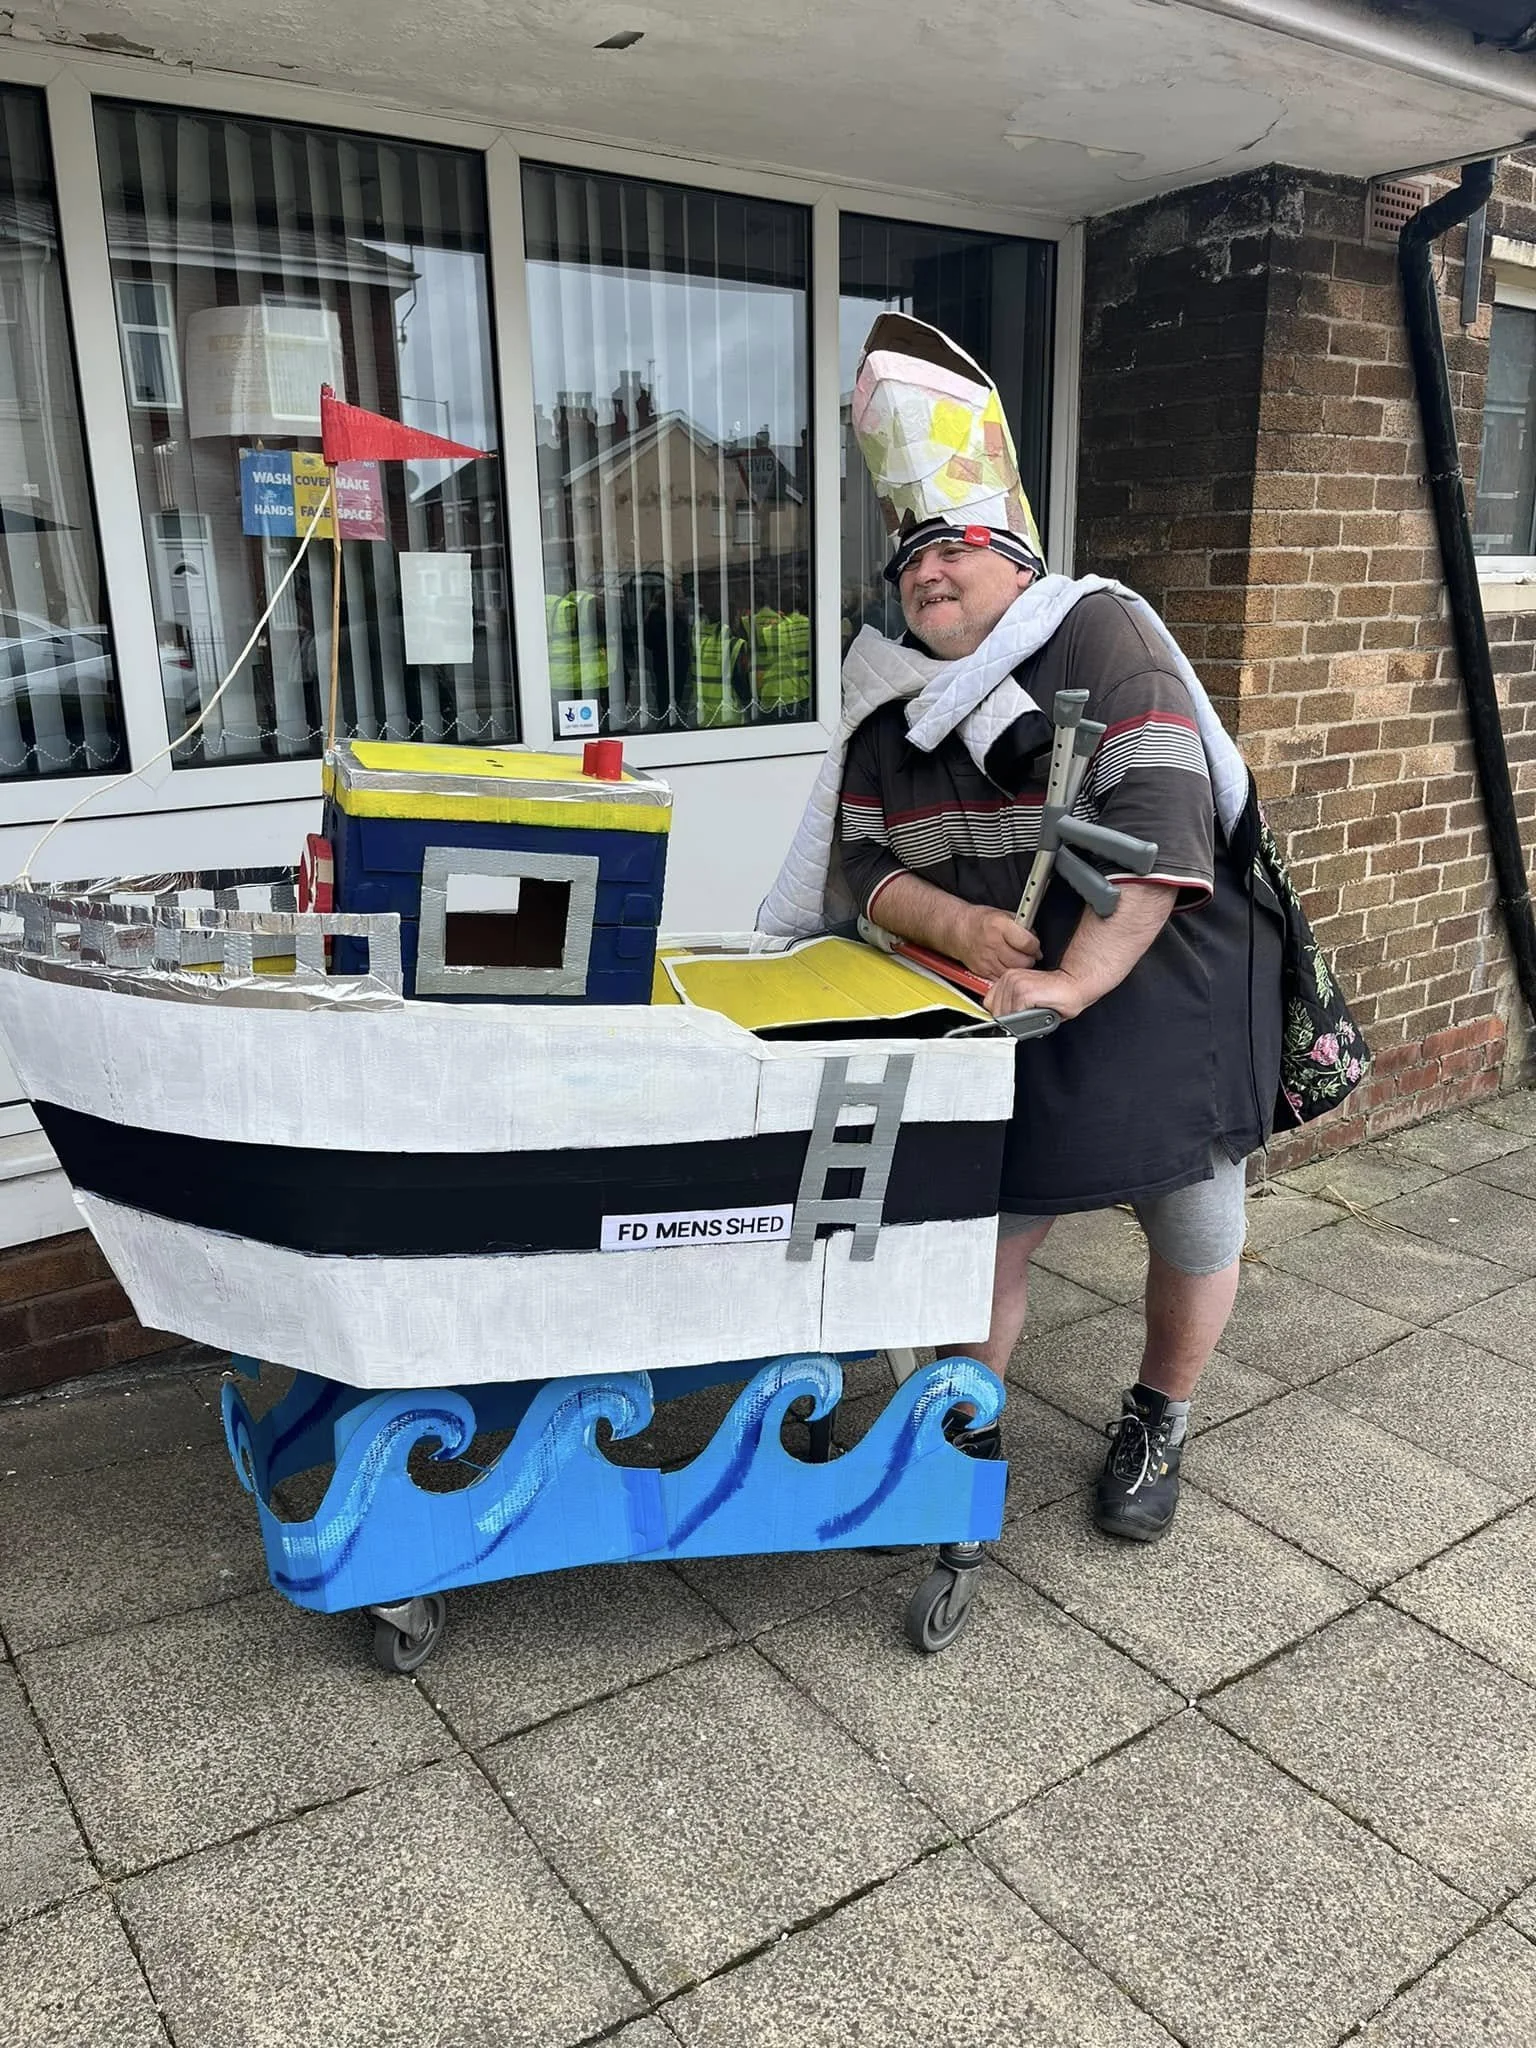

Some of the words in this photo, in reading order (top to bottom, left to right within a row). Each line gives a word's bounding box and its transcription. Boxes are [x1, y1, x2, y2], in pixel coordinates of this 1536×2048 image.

[252, 471, 292, 486] WASH
[336, 477, 370, 491] MAKE
[254, 503, 294, 517] HANDS
[337, 507, 373, 521] SPACE
[618, 1223, 648, 1241] FD
[655, 1219, 723, 1239] MENS
[725, 1215, 785, 1235] SHED
